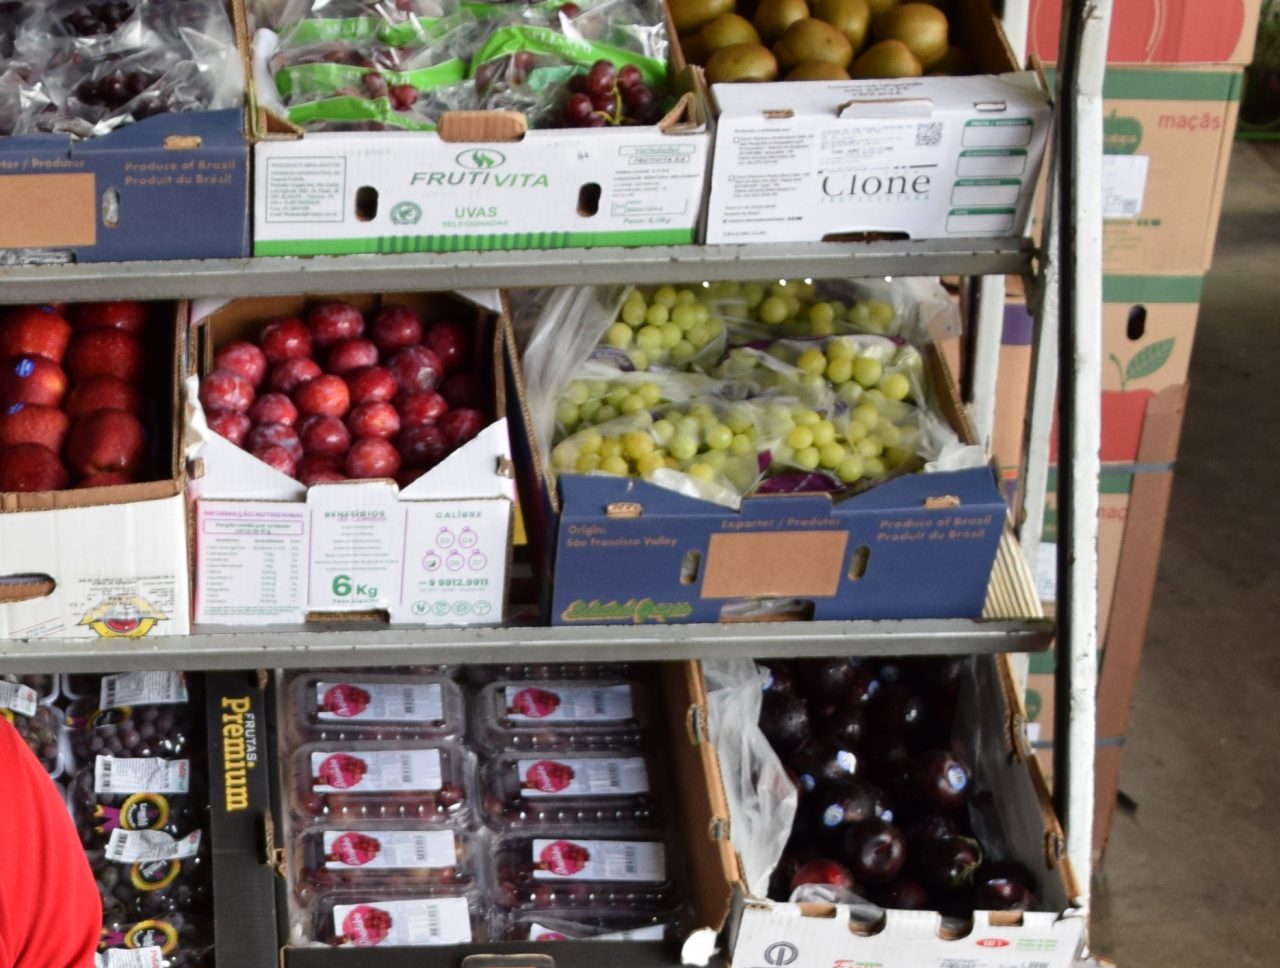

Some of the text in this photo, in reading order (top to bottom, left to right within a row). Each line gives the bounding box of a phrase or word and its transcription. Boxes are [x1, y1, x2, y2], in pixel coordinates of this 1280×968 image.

[1158, 112, 1221, 132] maçãs
[410, 171, 549, 187] FRUTIVITA
[821, 174, 931, 197] Clone
[454, 207, 497, 218] UVAS
[332, 574, 378, 598] 6 Kg
[244, 713, 257, 761] FRUTAS
[221, 696, 255, 812] Premium
